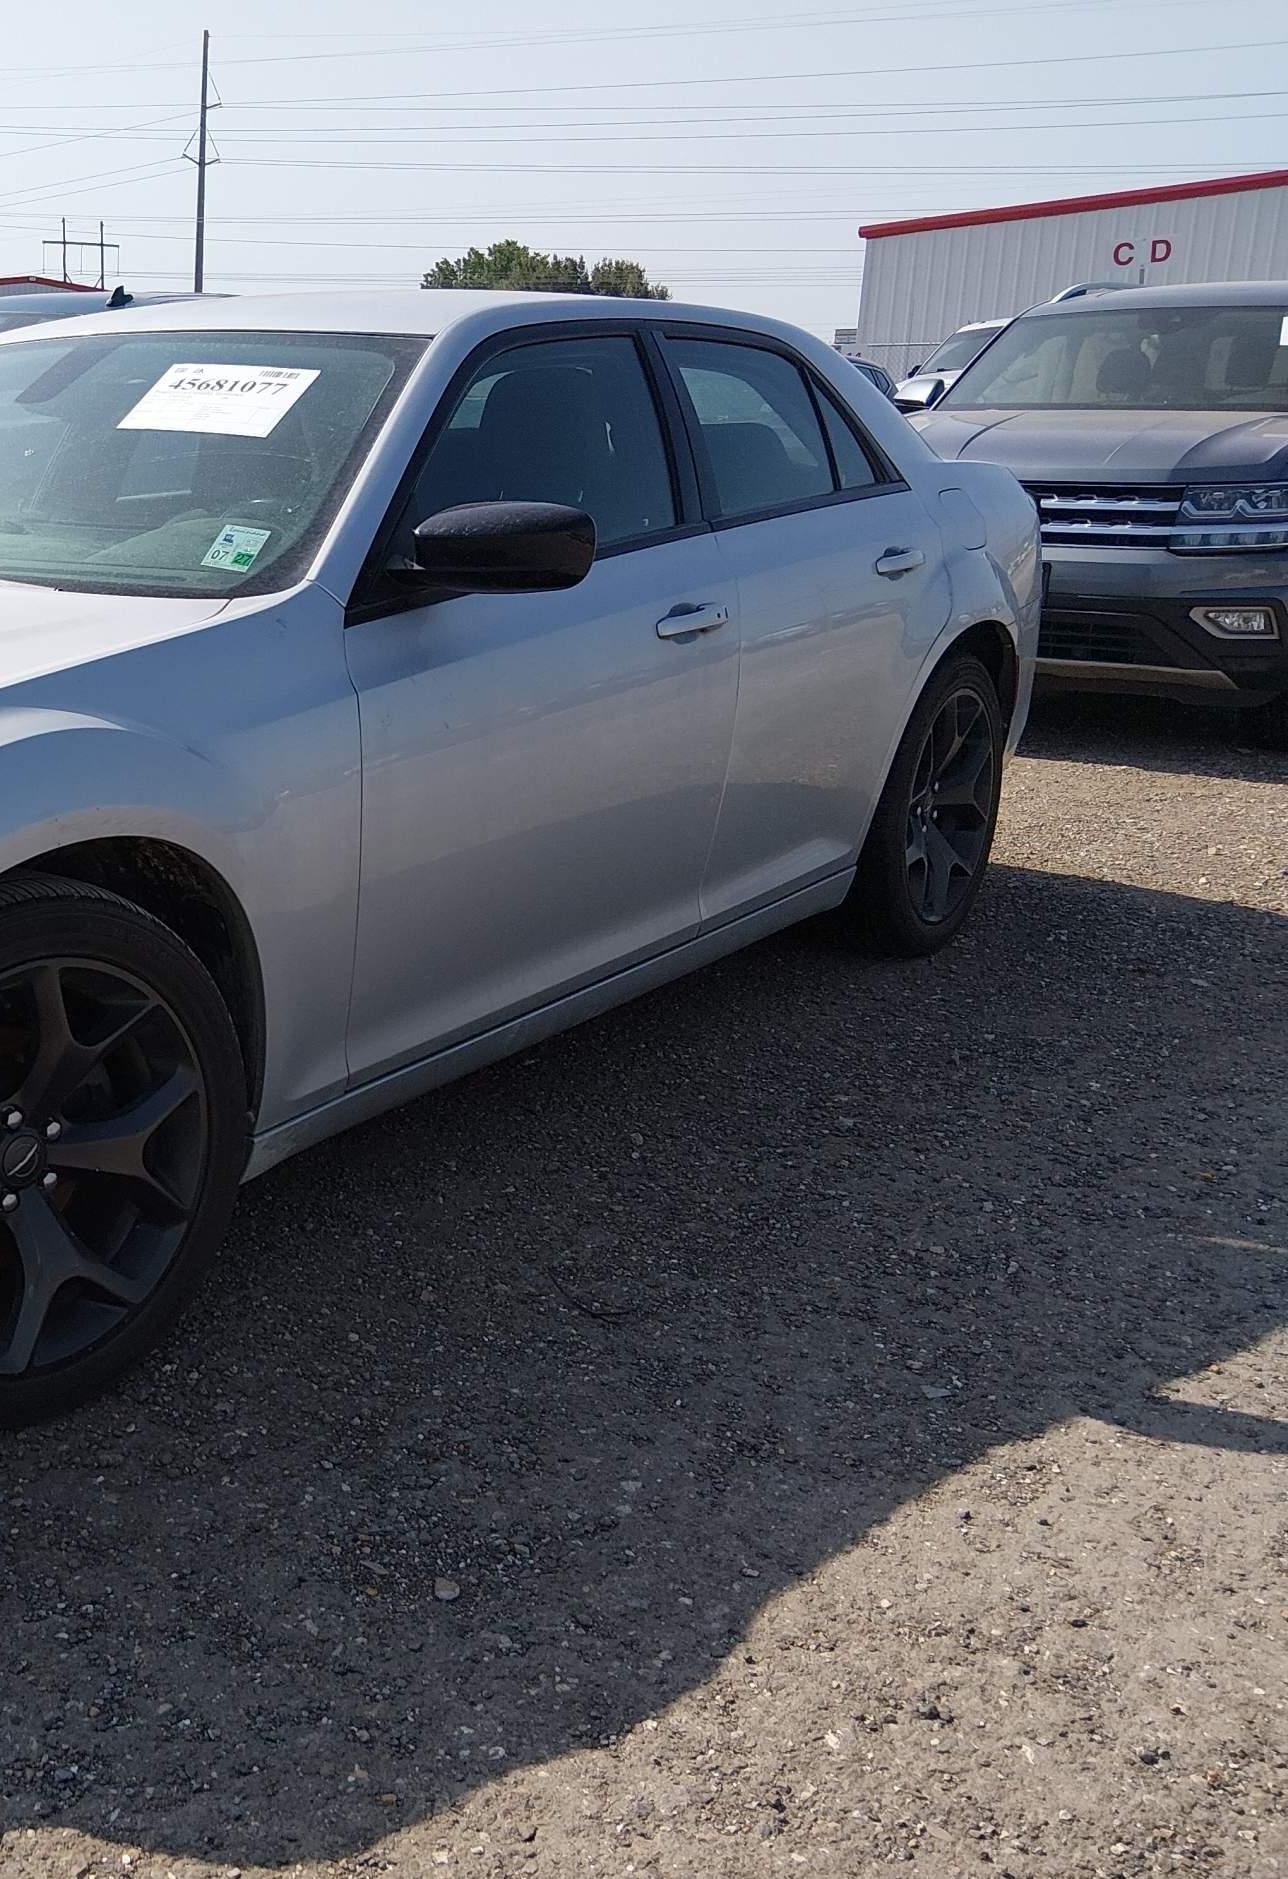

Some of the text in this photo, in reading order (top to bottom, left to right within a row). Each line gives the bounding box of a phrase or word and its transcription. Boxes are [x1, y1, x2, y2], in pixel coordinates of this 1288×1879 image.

[1113, 239, 1172, 266] C D
[168, 377, 290, 396] 45681077
[211, 549, 254, 566] 07 27
